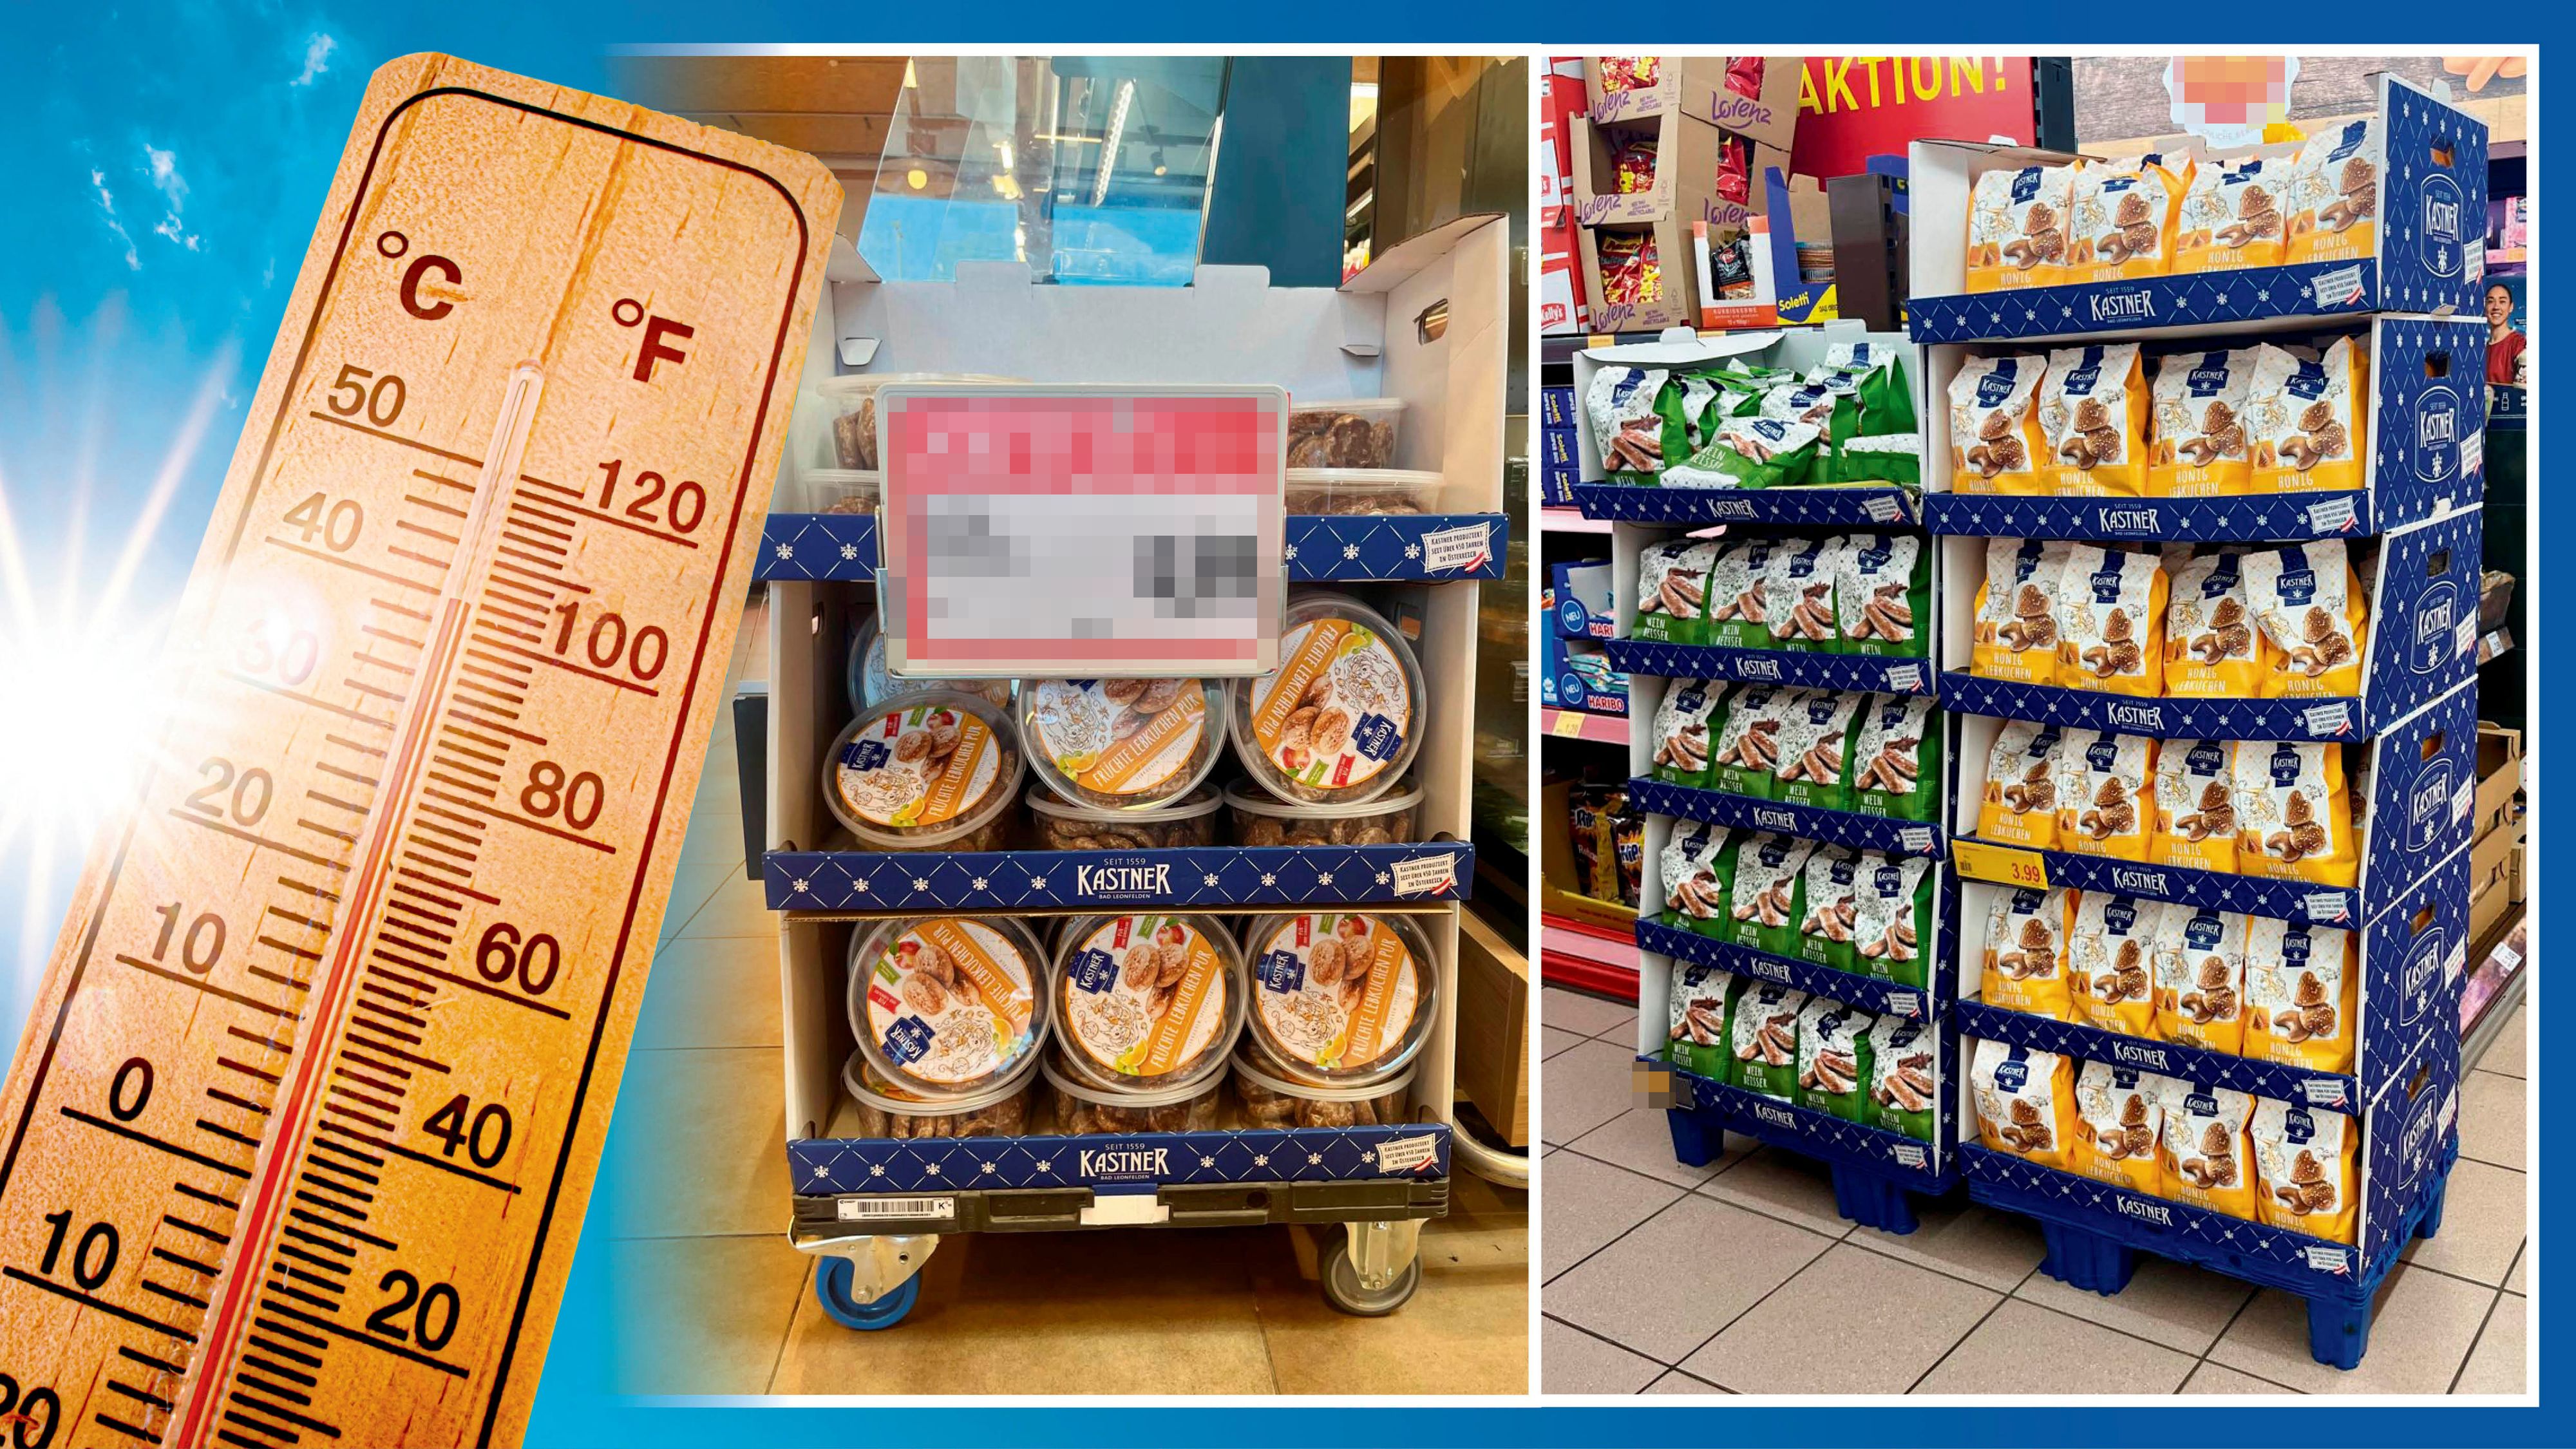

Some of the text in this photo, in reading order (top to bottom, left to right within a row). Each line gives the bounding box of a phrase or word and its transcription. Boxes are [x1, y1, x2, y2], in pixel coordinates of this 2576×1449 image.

[1798, 57, 2006, 115] AKTION!
[1592, 91, 1631, 122] Lorenz
[1712, 91, 1771, 129] Lorenz
[1578, 194, 1622, 224] Lorenz
[1704, 198, 1761, 225] Loren
[2425, 195, 2459, 242] KASTNER
[2313, 236, 2348, 250] HONIG
[2208, 251, 2243, 264] HONIG
[2001, 273, 2031, 285] HONIG
[2093, 269, 2123, 281] HONIG
[1779, 292, 1810, 312] Soletti
[2090, 290, 2156, 322] KASTNER
[1593, 304, 1635, 332] Lorenz
[2069, 370, 2097, 381] KASTNER
[2191, 370, 2225, 381] KASTNER
[328, 363, 406, 426] 50
[1982, 379, 2012, 394] KASTNER
[2420, 410, 2456, 449] KASTNER
[2061, 472, 2094, 484] HONIG
[2176, 469, 2208, 482] HONIG
[2277, 472, 2313, 488] HONIG
[599, 458, 707, 532] 120
[1707, 498, 1760, 518] KASTNER
[283, 491, 363, 552] 40
[2099, 508, 2161, 533] KASTNER
[2092, 576, 2117, 587] KASTNER
[2280, 576, 2314, 589] KASTNER
[1566, 611, 1580, 623] NEU
[1646, 618, 1665, 629] WEIN
[2417, 598, 2452, 645] KASTNER
[556, 600, 669, 681] 100
[1304, 624, 1339, 667] FRÜCHTE
[1861, 644, 1881, 655] WEIN
[234, 620, 318, 685] 30
[1993, 652, 2023, 665] HONIG
[1736, 657, 1783, 680] KASTNER
[2188, 668, 2217, 679] HONIG
[1273, 667, 1312, 721] LEBKUCHEN
[1566, 685, 1580, 695] NEU
[2081, 677, 2110, 691] HONIG
[2287, 679, 2324, 691] HONIG
[1587, 695, 1624, 712] HARIBO
[1811, 700, 1835, 711] KASTNER
[2107, 702, 2164, 730] KASTNER
[1259, 717, 1278, 737] PUR
[1092, 750, 1134, 786] FRÜCHTE
[1133, 711, 1181, 756] LEBKUCHEN
[1177, 694, 1200, 715] PUR
[1365, 721, 1392, 756] KASTNER
[852, 743, 876, 769] KASTNER
[2089, 748, 2114, 758] KASTNER
[2190, 750, 2219, 762] KASTNER
[2273, 757, 2299, 769] KASTNER
[928, 784, 956, 817] FRÜCHTE
[947, 741, 975, 783] LEBKUCHEN
[967, 724, 983, 740] PUR
[185, 757, 273, 826] 20
[520, 761, 605, 831] 80
[1789, 785, 1808, 795] WEIN
[1863, 795, 1882, 805] WEIN
[2413, 773, 2447, 826] KASTNER
[1753, 806, 1798, 832] KASTNER
[1999, 814, 2023, 826] HONIG
[2078, 841, 2107, 851] HONIG
[2172, 844, 2201, 855] HONIG
[1877, 872, 1899, 882] KASTNER
[2012, 863, 2040, 882] 3.99
[2266, 864, 2299, 875] HONIG
[1077, 864, 1173, 896] KASTNER
[2112, 867, 2170, 896] KASTNER
[2107, 907, 2133, 921] KASTNER
[934, 923, 952, 943] PUR
[1740, 924, 1757, 936] WEIN
[2189, 921, 2219, 934] KASTNER
[153, 902, 225, 974] 10
[1806, 940, 1823, 952] WEIN
[2285, 938, 2308, 950] KASTNER
[476, 923, 560, 996] 60
[948, 940, 996, 989] LEBKUCHEN
[1871, 963, 1888, 974] WEIN
[1080, 953, 1104, 989] KASTNER
[1269, 954, 1289, 989] KASTNER
[1751, 957, 1793, 983] KASTNER
[2405, 942, 2439, 999] KASTNER
[990, 984, 1027, 1021] FRÜCHTE
[1351, 938, 1397, 1058] FRÜCHTE LEBKUCHEN PUR
[1150, 1025, 1179, 1068] FRÜCHTE
[1168, 969, 1202, 1025] LEBKUCHEN
[1193, 950, 1212, 967] PUR
[2091, 1004, 2116, 1017] HONIG
[2177, 1022, 2205, 1037] HONIG
[891, 1025, 922, 1058] KASTNER
[1674, 1044, 1690, 1054] WEIN
[2270, 1043, 2302, 1056] HONIG
[2113, 1041, 2170, 1070] KASTNER
[1747, 1066, 1763, 1077] WEIN
[1998, 1065, 2025, 1079] KASTNER
[110, 1057, 153, 1121] 0
[2186, 1098, 2214, 1112] KASTNER
[1754, 1103, 1797, 1130] KASTNER
[2288, 1114, 2311, 1128] KASTNER
[424, 1094, 511, 1169] 40
[2403, 1099, 2433, 1164] KASTNER
[1080, 1148, 1171, 1177] KASTNER
[2094, 1156, 2121, 1171] HONIG
[2181, 1185, 2209, 1199] HONIG
[2116, 1195, 2173, 1226] KASTNER
[2275, 1211, 2306, 1228] HONIG
[41, 1209, 119, 1289] 10
[366, 1270, 459, 1351] 20
